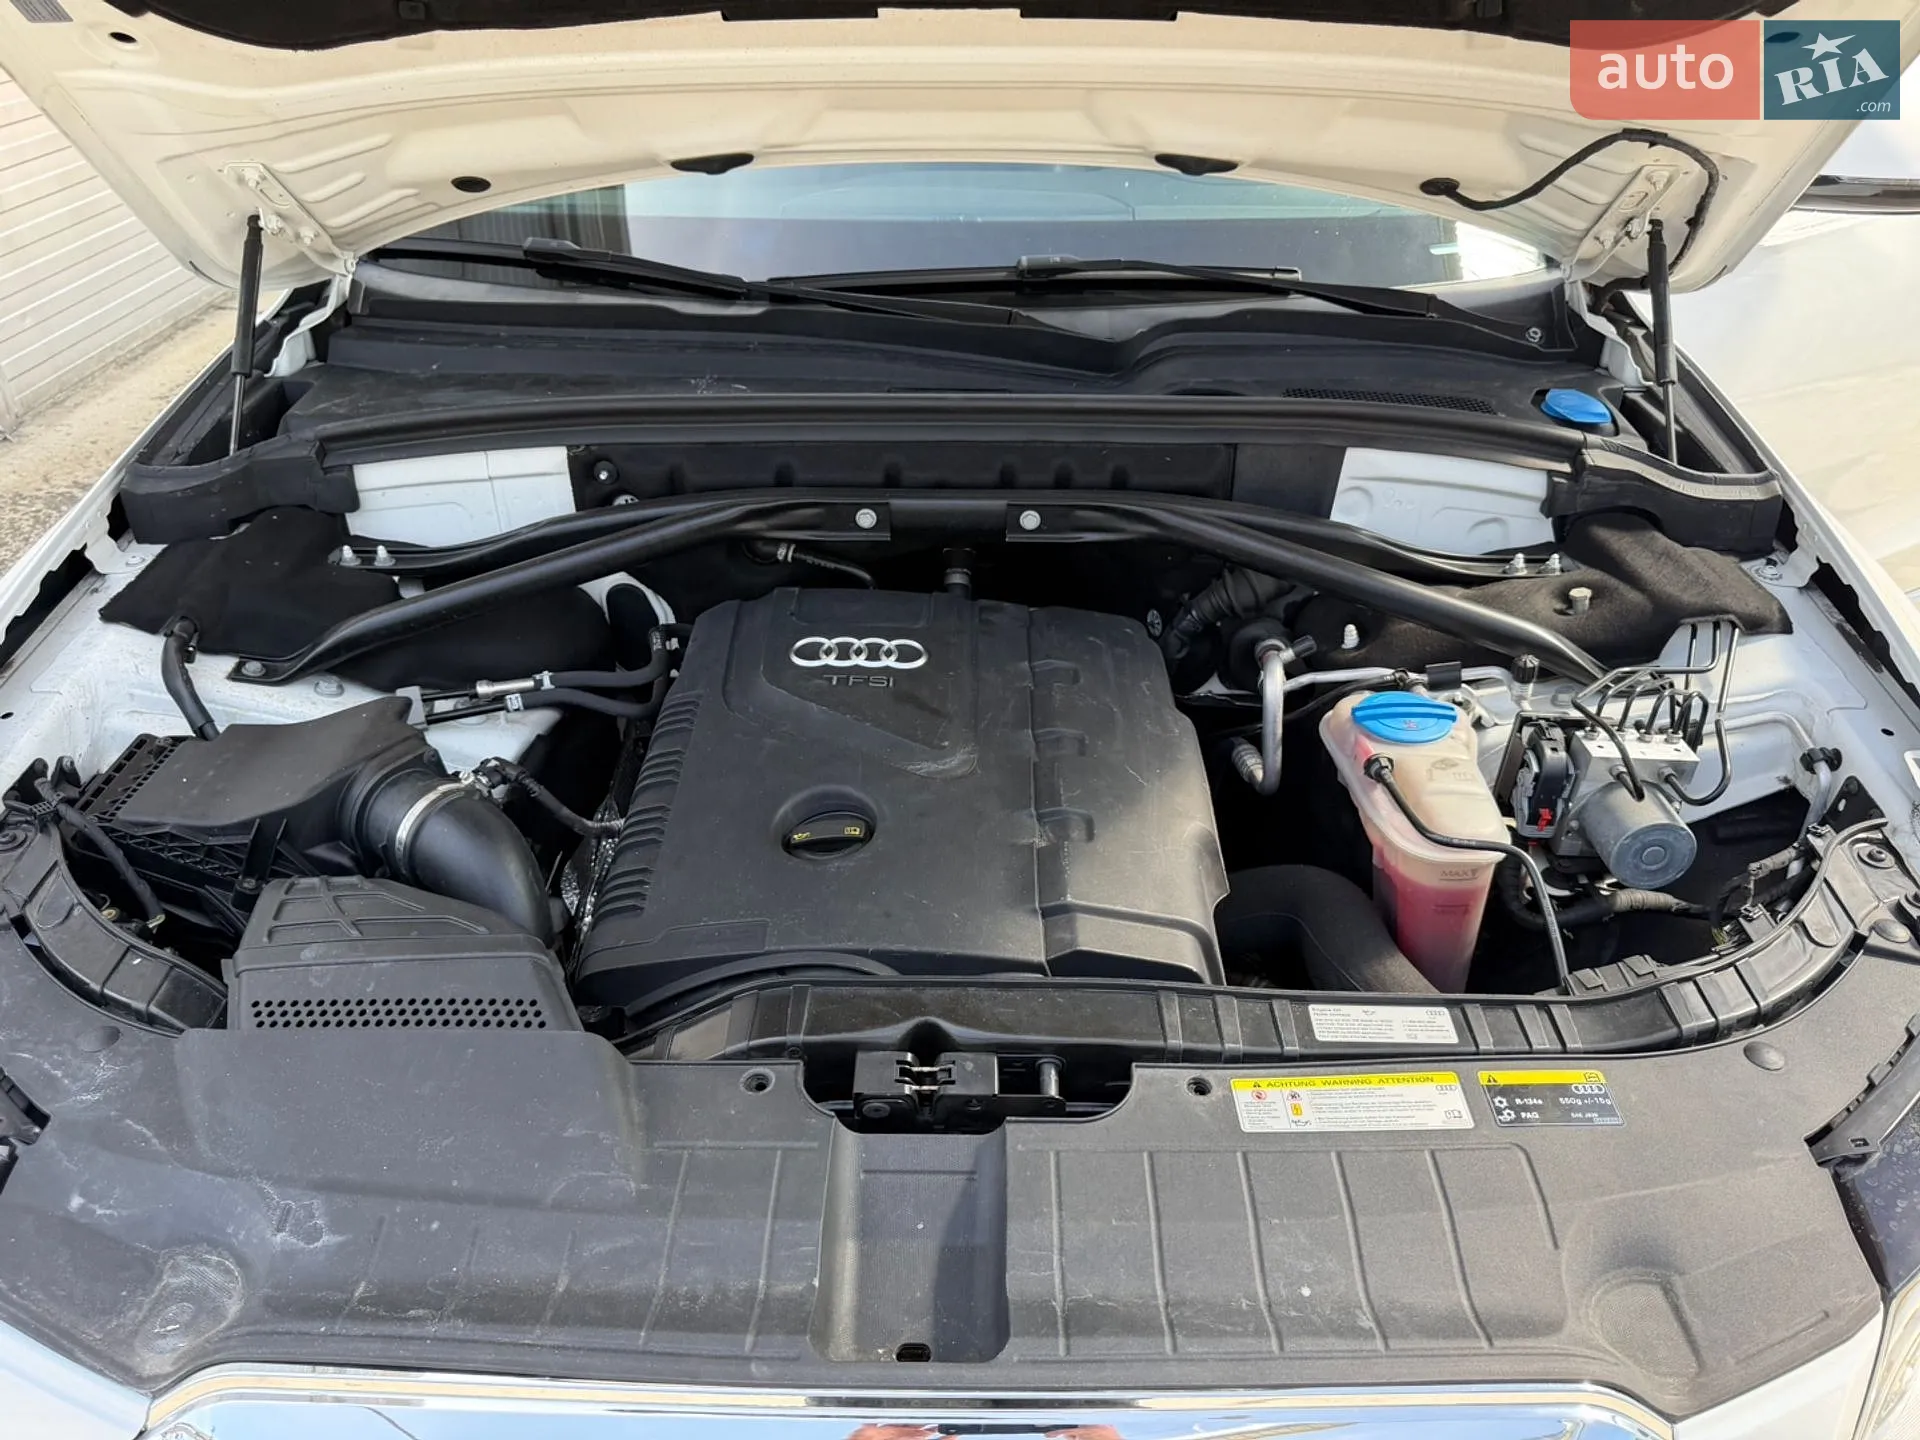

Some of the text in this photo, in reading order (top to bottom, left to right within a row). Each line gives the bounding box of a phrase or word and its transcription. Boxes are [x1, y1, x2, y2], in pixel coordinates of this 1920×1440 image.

[823, 674, 894, 688] TFSI
[1321, 1078, 1372, 1087] WARNING
[1378, 1075, 1435, 1084] ATTENTION
